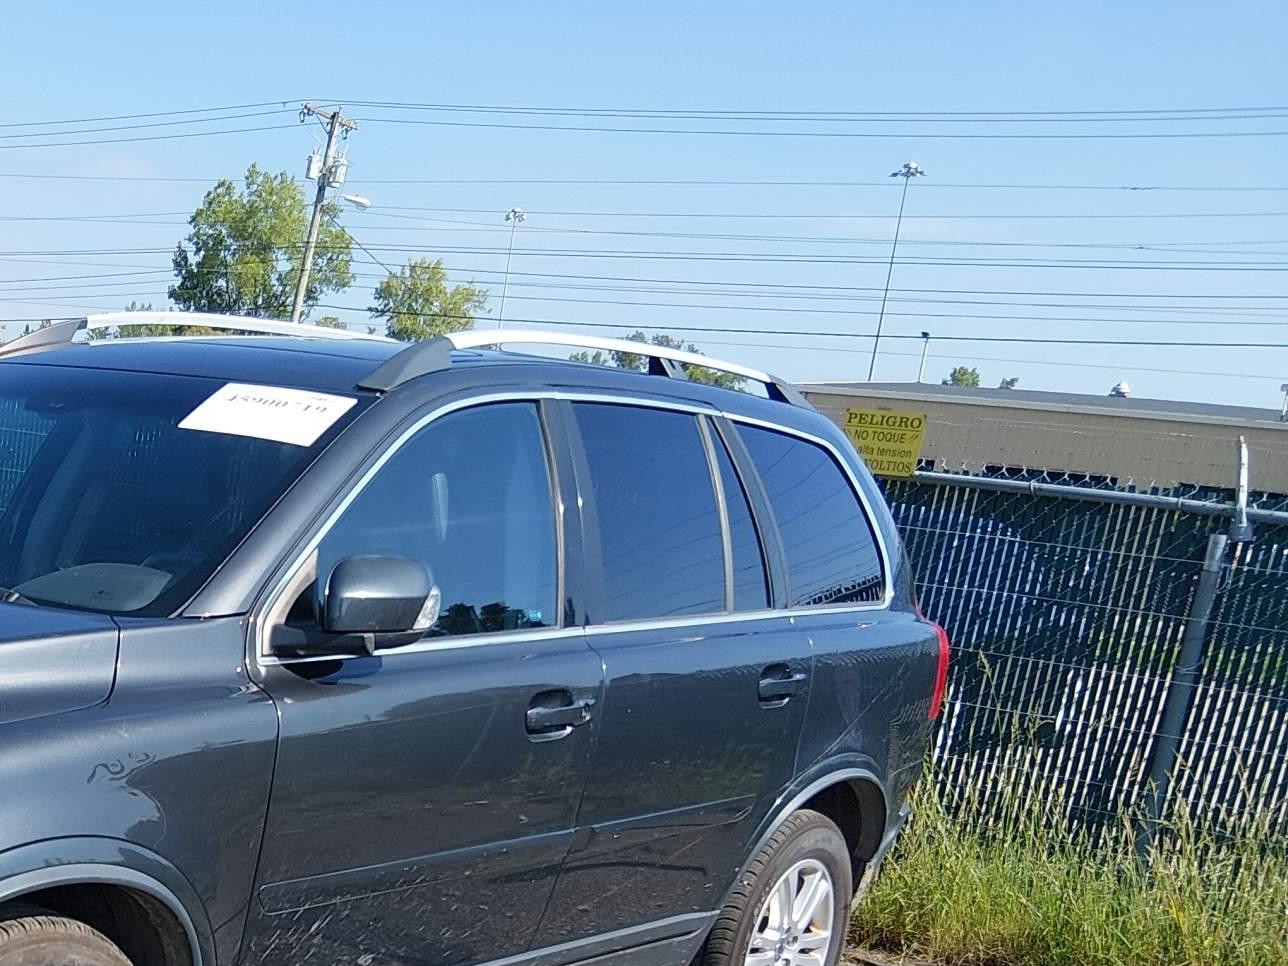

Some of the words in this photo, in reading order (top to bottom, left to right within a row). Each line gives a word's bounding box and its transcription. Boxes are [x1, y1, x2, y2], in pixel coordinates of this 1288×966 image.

[846, 412, 922, 429] PELIGRO
[853, 429, 869, 441] NO
[872, 430, 907, 443] TOQUE
[876, 445, 912, 458] tension
